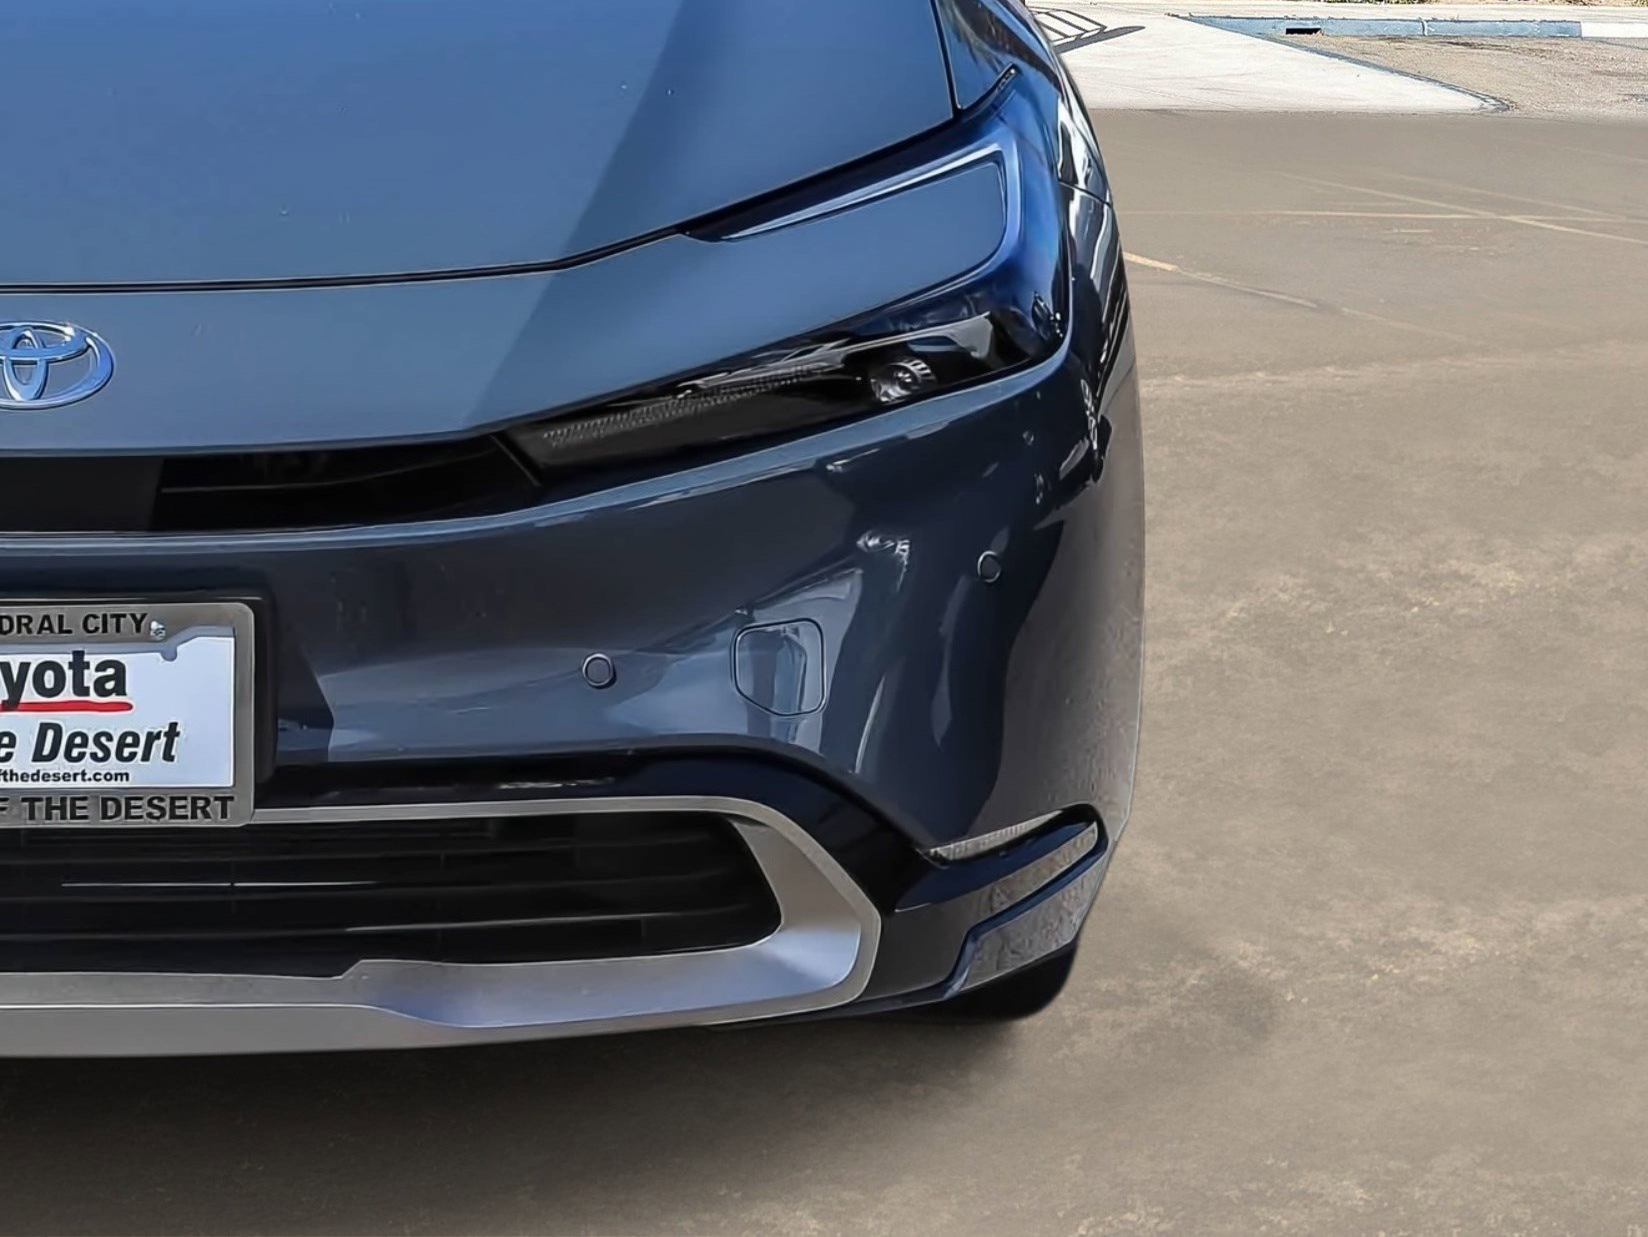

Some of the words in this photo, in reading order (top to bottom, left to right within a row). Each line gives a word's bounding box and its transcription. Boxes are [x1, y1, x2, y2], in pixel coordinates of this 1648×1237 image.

[81, 612, 148, 634] CITY
[31, 722, 181, 764] Desert
[21, 797, 90, 822] THE
[99, 795, 235, 821] DESERT
